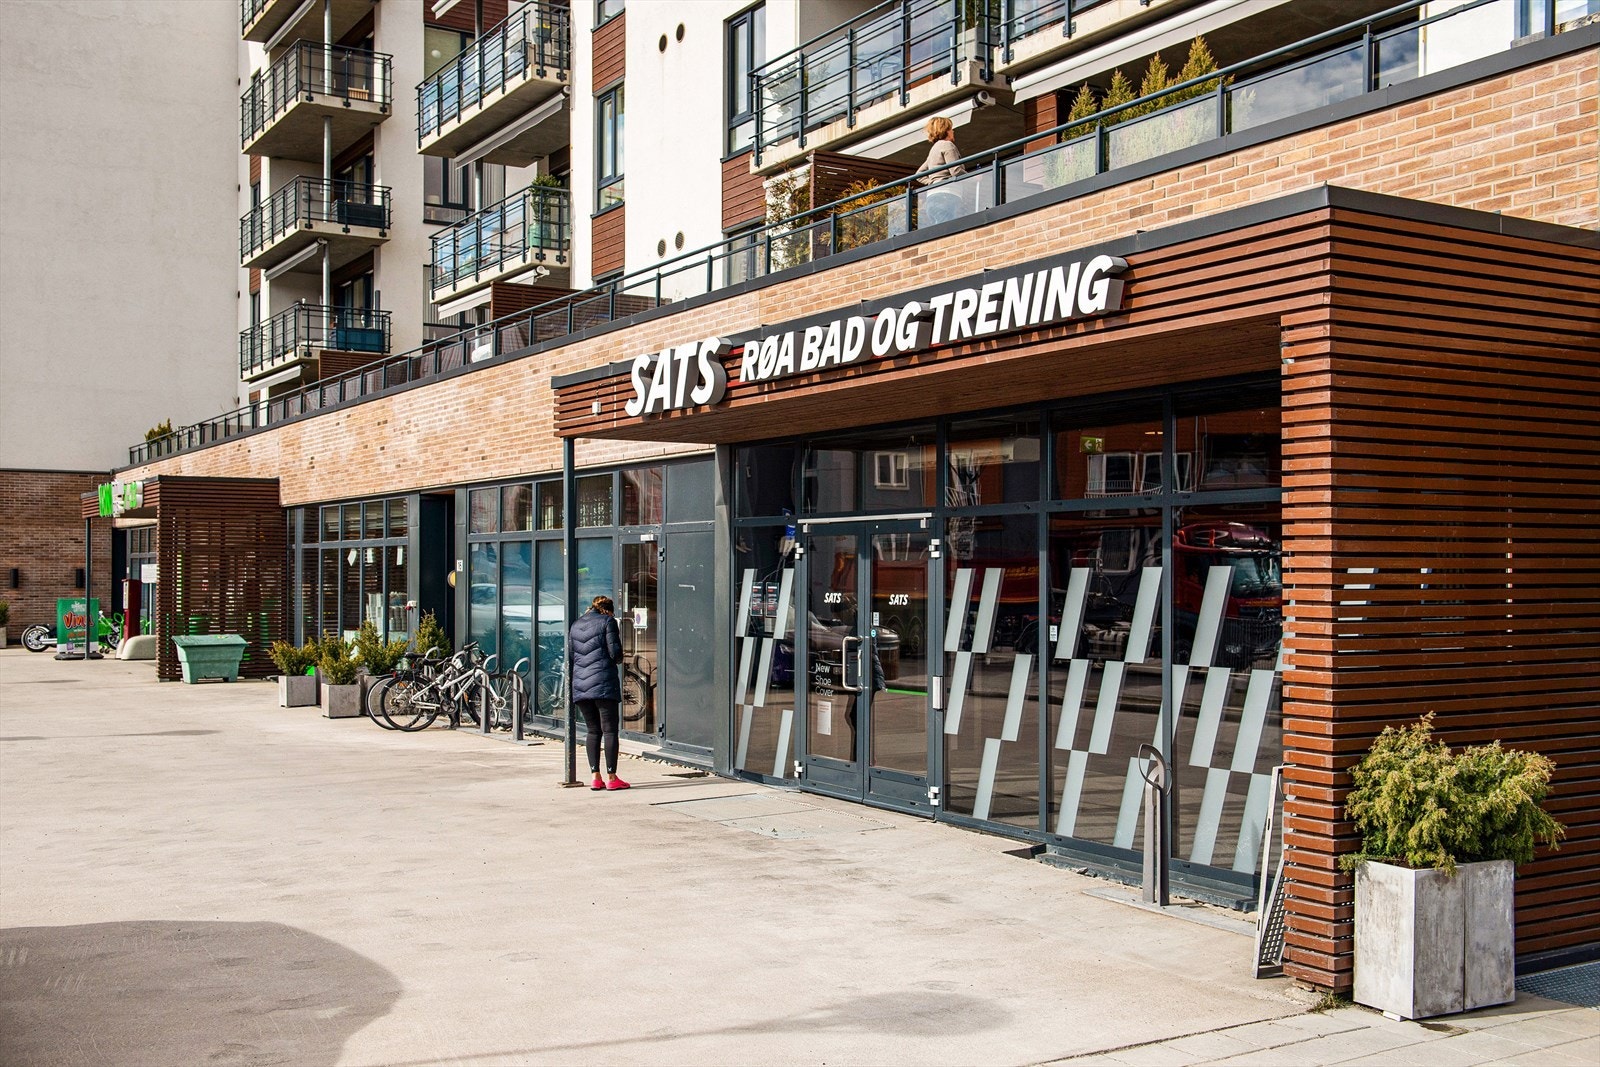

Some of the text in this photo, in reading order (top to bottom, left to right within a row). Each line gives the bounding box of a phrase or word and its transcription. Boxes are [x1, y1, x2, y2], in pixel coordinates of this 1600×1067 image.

[625, 255, 1112, 416] SATS RØA BAD OG TRENING
[823, 593, 842, 604] SATS
[888, 594, 909, 606] SATS
[815, 662, 831, 673] New
[815, 675, 832, 686] Shoe
[815, 686, 834, 697] Cover
